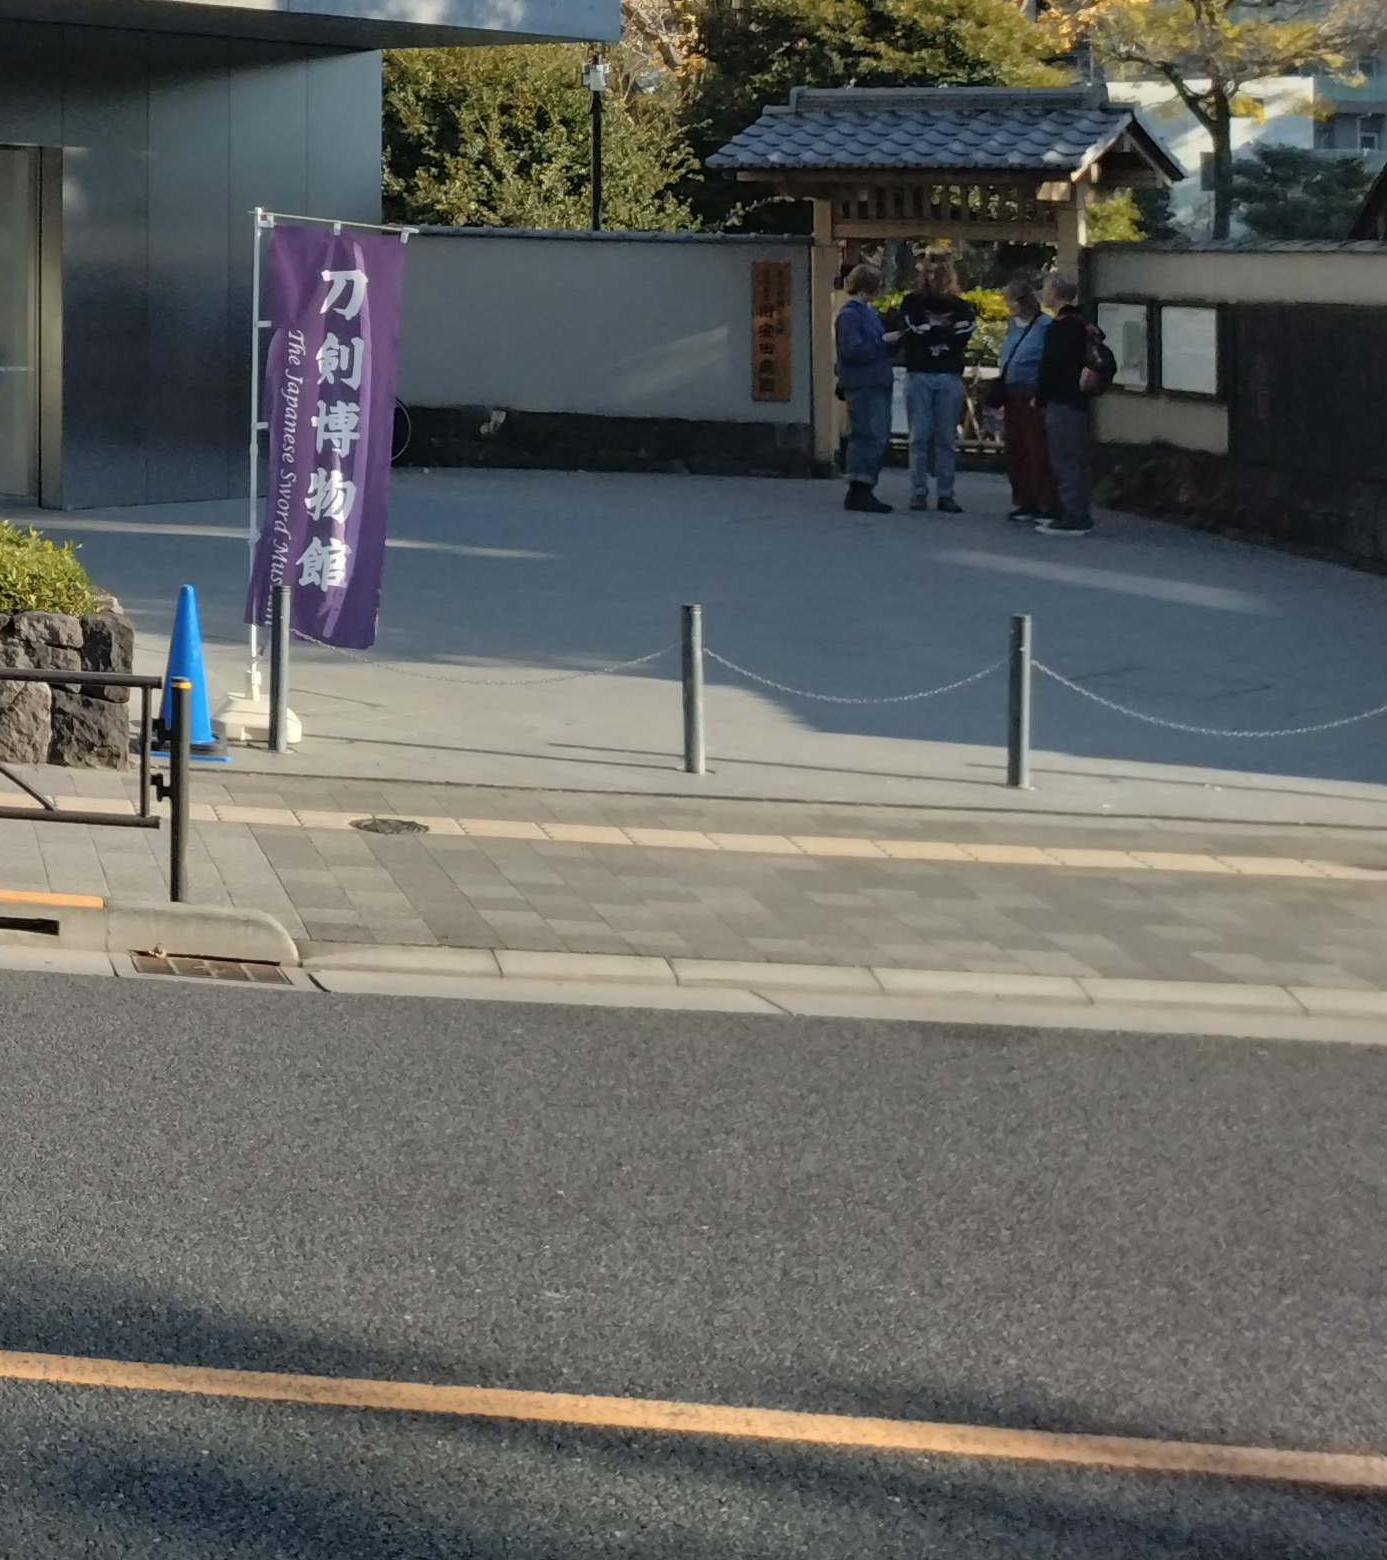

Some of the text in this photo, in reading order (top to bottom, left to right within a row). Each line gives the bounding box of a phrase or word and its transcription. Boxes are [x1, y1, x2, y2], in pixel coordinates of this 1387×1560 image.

[287, 329, 306, 366] The
[280, 368, 304, 464] Japanese
[296, 269, 368, 593] 刀剣博物館
[274, 468, 297, 541] Sword
